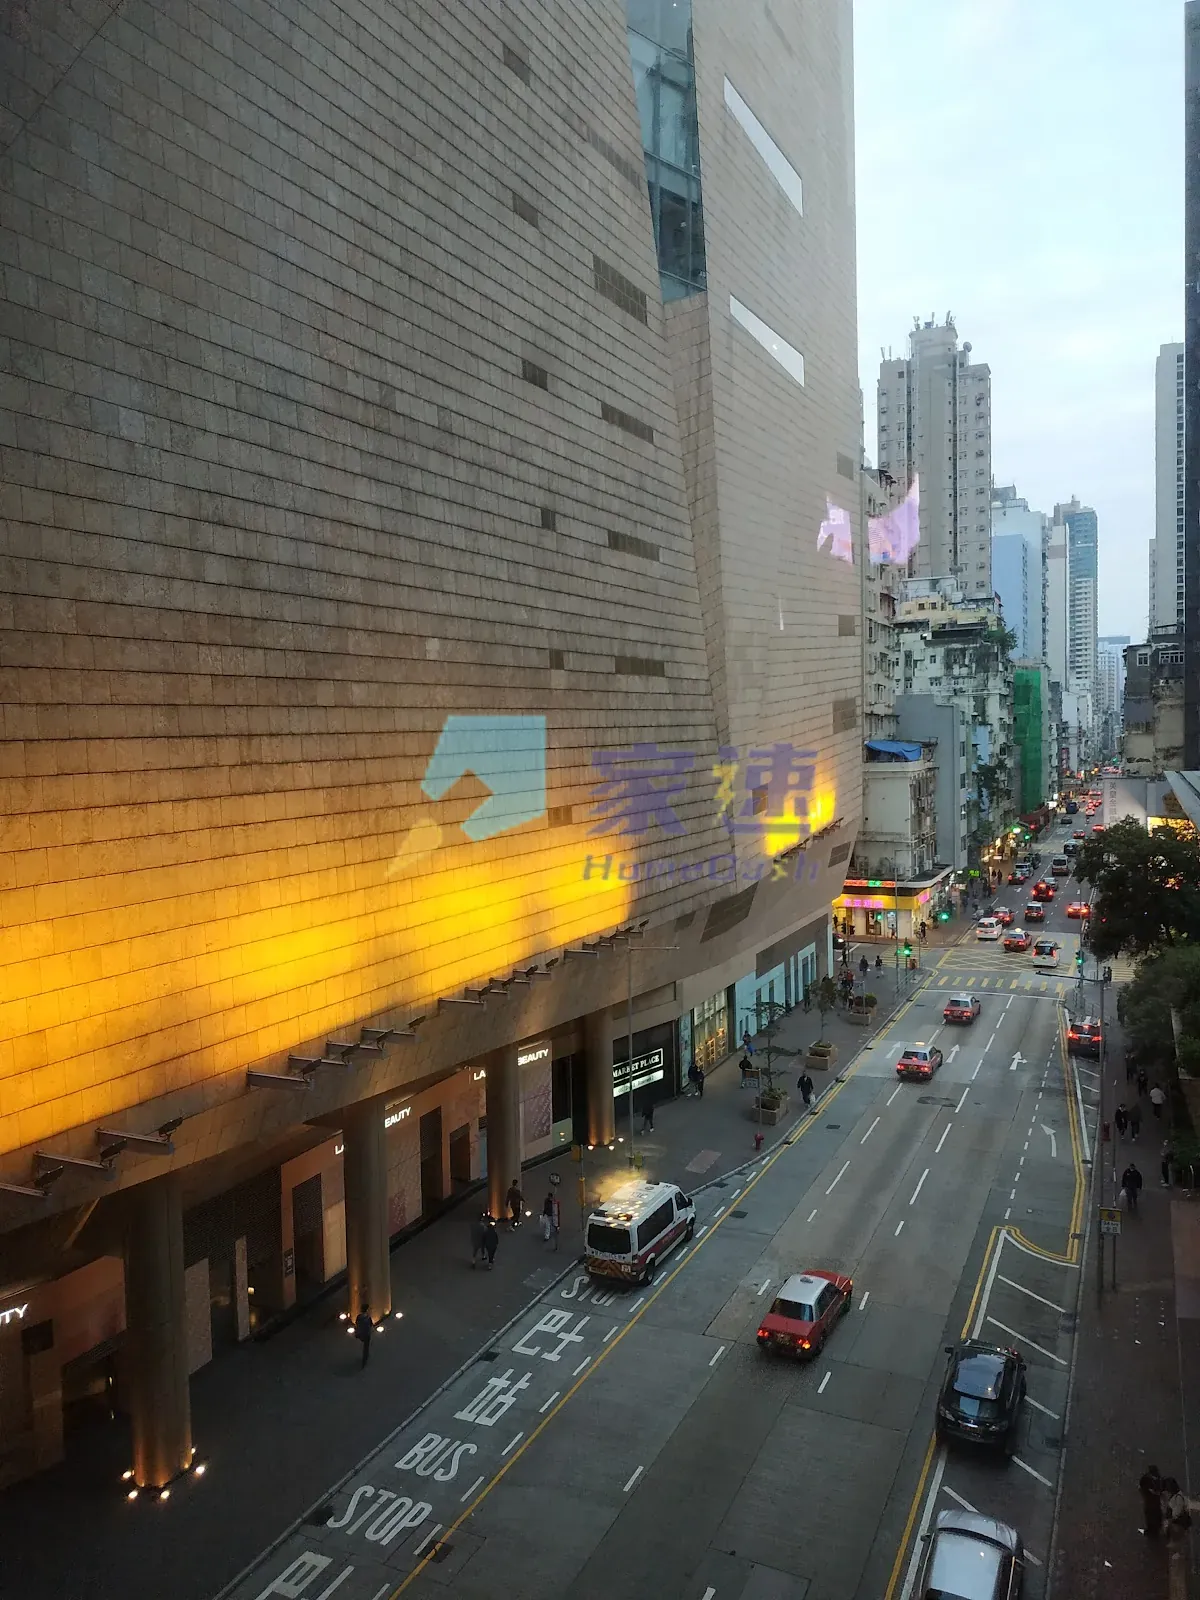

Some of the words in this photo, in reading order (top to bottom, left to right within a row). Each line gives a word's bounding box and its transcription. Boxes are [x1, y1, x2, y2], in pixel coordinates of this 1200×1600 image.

[518, 1048, 549, 1066] BEAUTY
[640, 1054, 660, 1068] PLACE
[0, 1303, 29, 1326] TY
[511, 1308, 591, 1361] 巴士
[453, 1368, 533, 1426] 站
[394, 1432, 478, 1481] BUS
[326, 1485, 433, 1546] STOP
